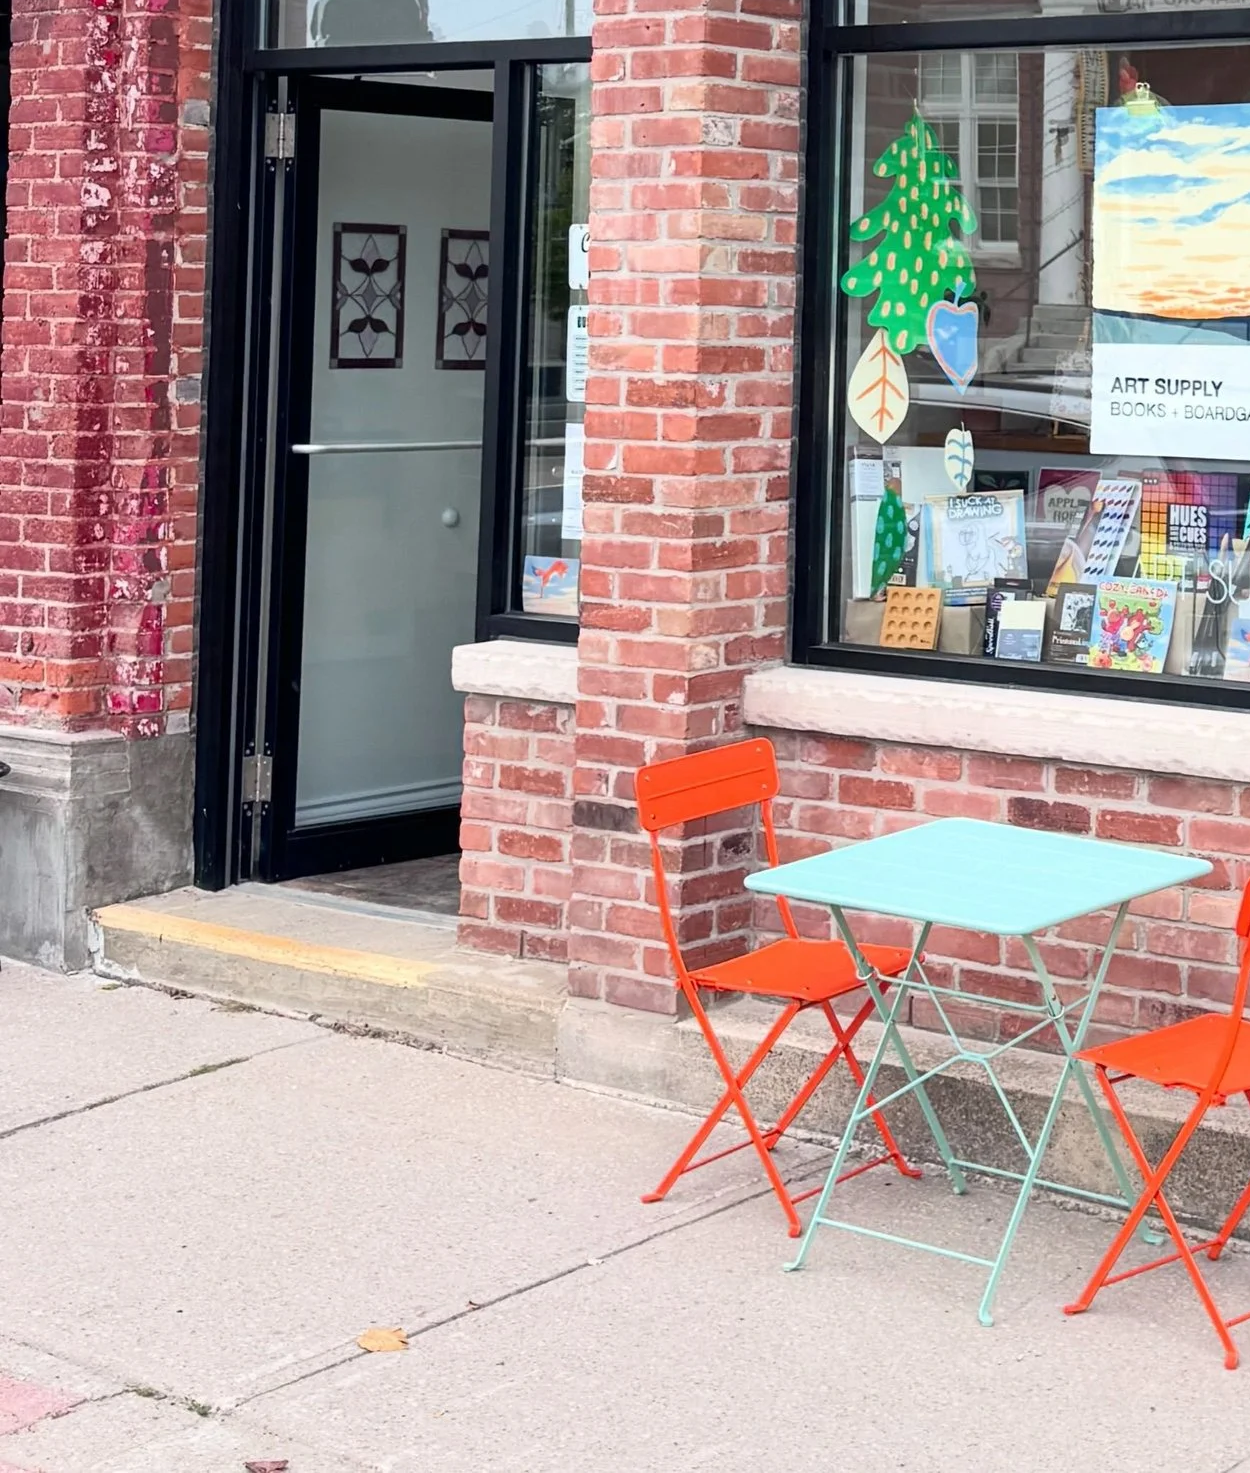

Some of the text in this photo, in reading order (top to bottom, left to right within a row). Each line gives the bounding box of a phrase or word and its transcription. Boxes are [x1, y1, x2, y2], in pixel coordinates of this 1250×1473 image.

[1110, 376, 1223, 398] ART SUPPLY
[1110, 401, 1167, 418] BOOKS
[955, 496, 982, 508] SUCK
[948, 504, 1002, 519] DRAWING
[1169, 504, 1208, 528] HUES
[1179, 526, 1207, 544] CUES
